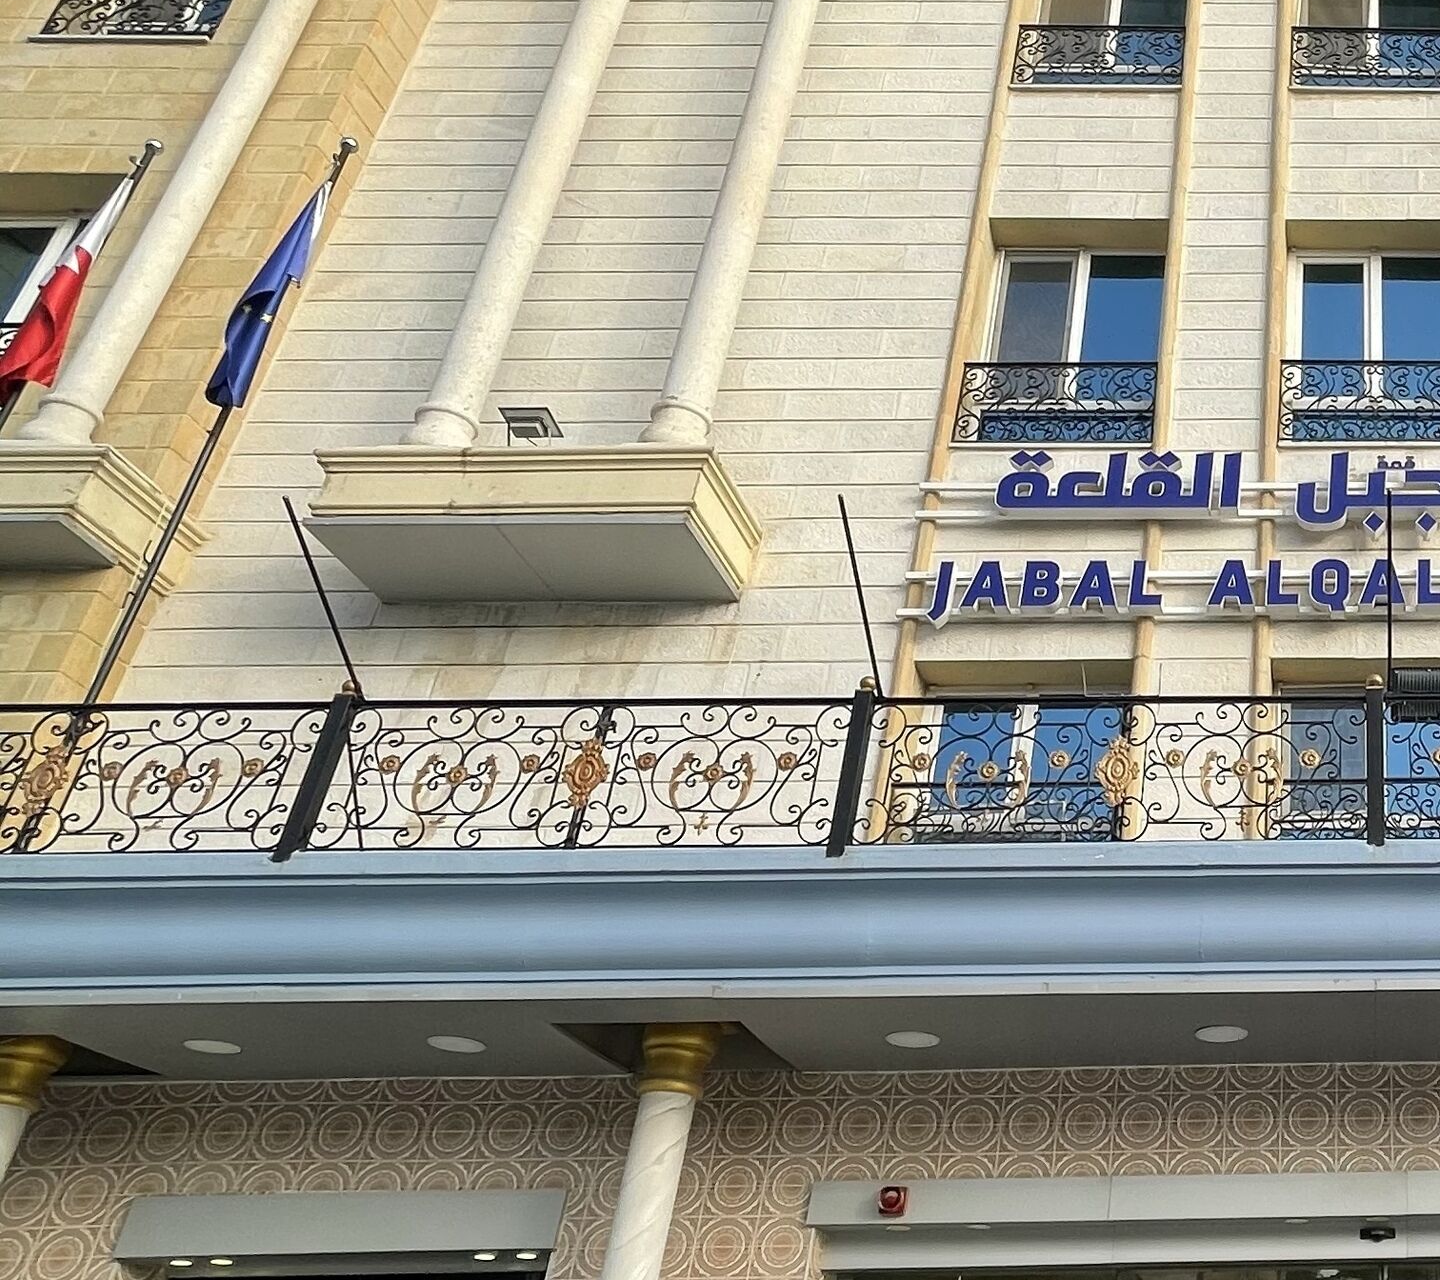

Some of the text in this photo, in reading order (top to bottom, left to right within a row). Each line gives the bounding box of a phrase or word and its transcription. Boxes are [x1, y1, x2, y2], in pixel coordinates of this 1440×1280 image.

[994, 449, 1243, 513] القلعة
[1376, 455, 1416, 470] قمة
[926, 560, 1163, 624] JABAL
